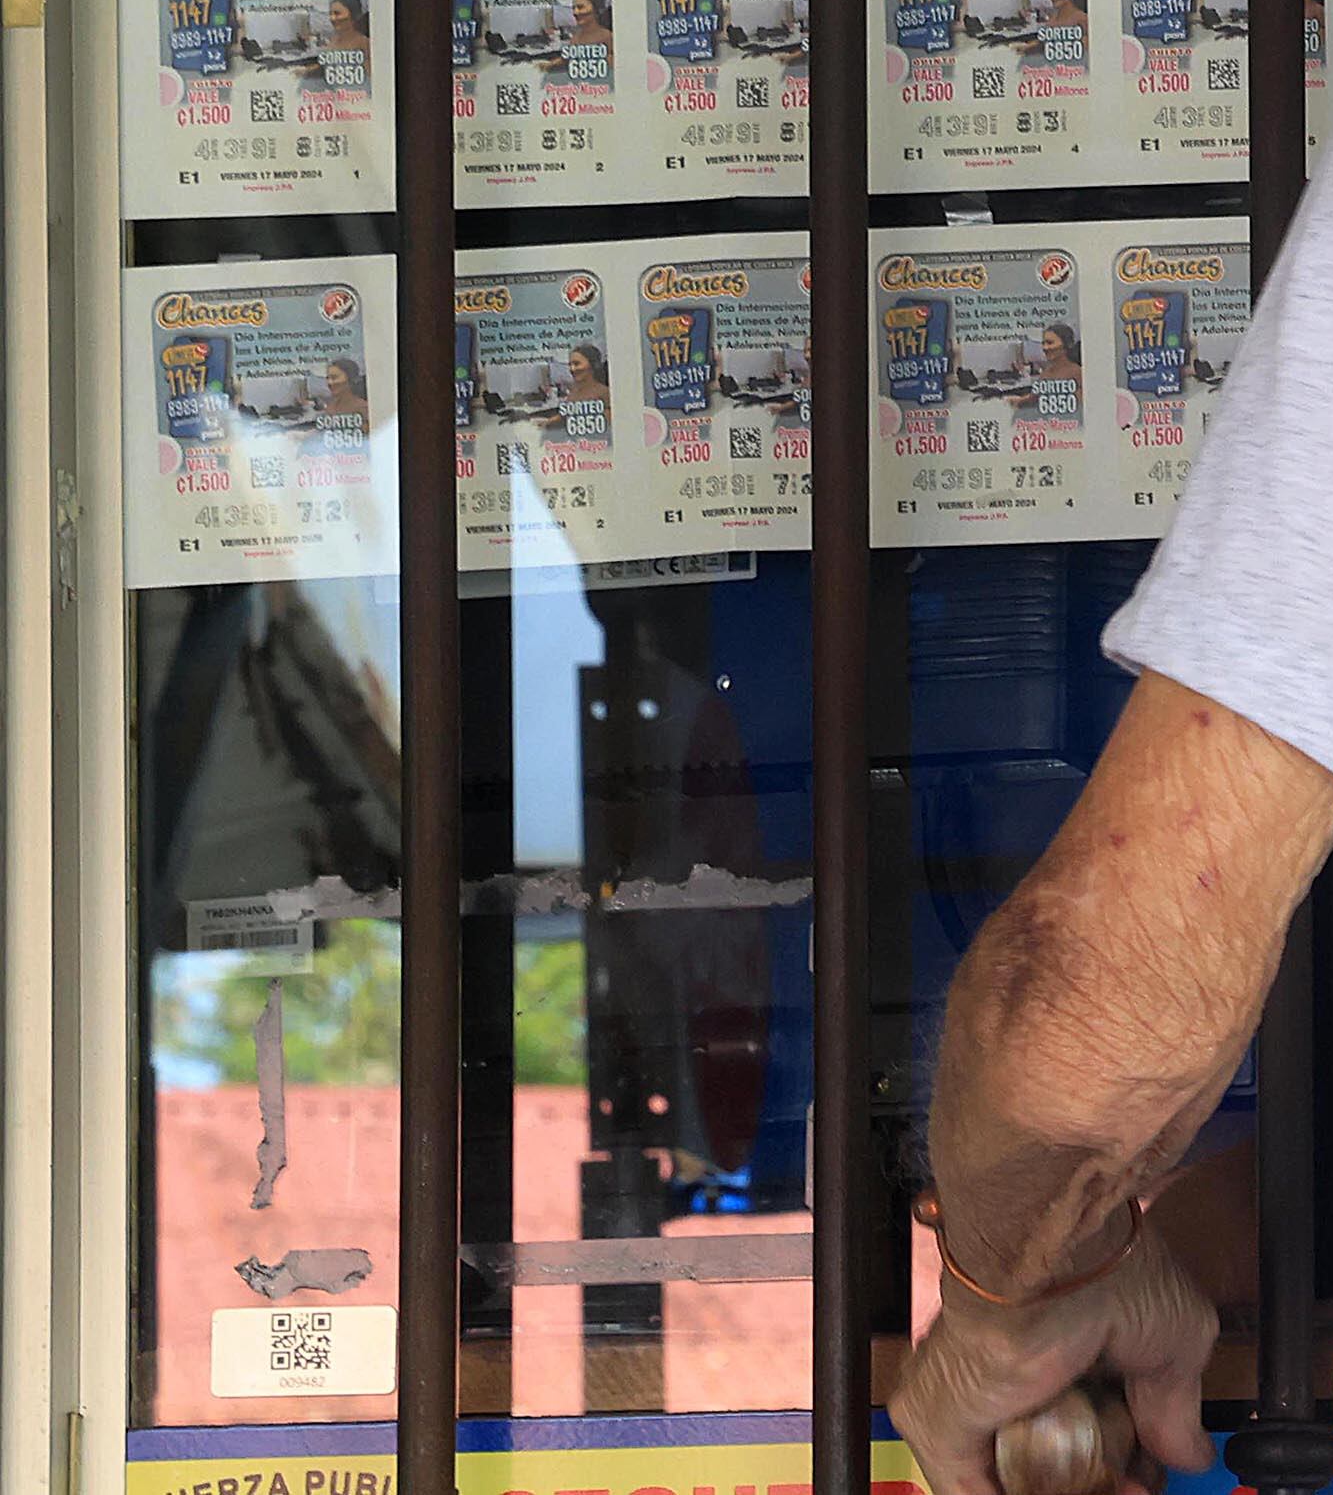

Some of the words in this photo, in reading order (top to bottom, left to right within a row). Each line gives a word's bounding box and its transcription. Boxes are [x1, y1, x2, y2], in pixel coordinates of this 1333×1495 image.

[895, 5, 955, 28] 8989-1147
[1038, 27, 1082, 41] SORTEO
[318, 51, 364, 65] SORTEO
[1045, 41, 1082, 60] 6850
[325, 65, 364, 85] 6850
[904, 147, 923, 160] E1
[881, 253, 987, 294] Chances
[1119, 245, 1224, 286] Chances
[158, 290, 268, 332] Chances
[1031, 380, 1076, 394] SORTEO
[1039, 394, 1076, 414] 6850
